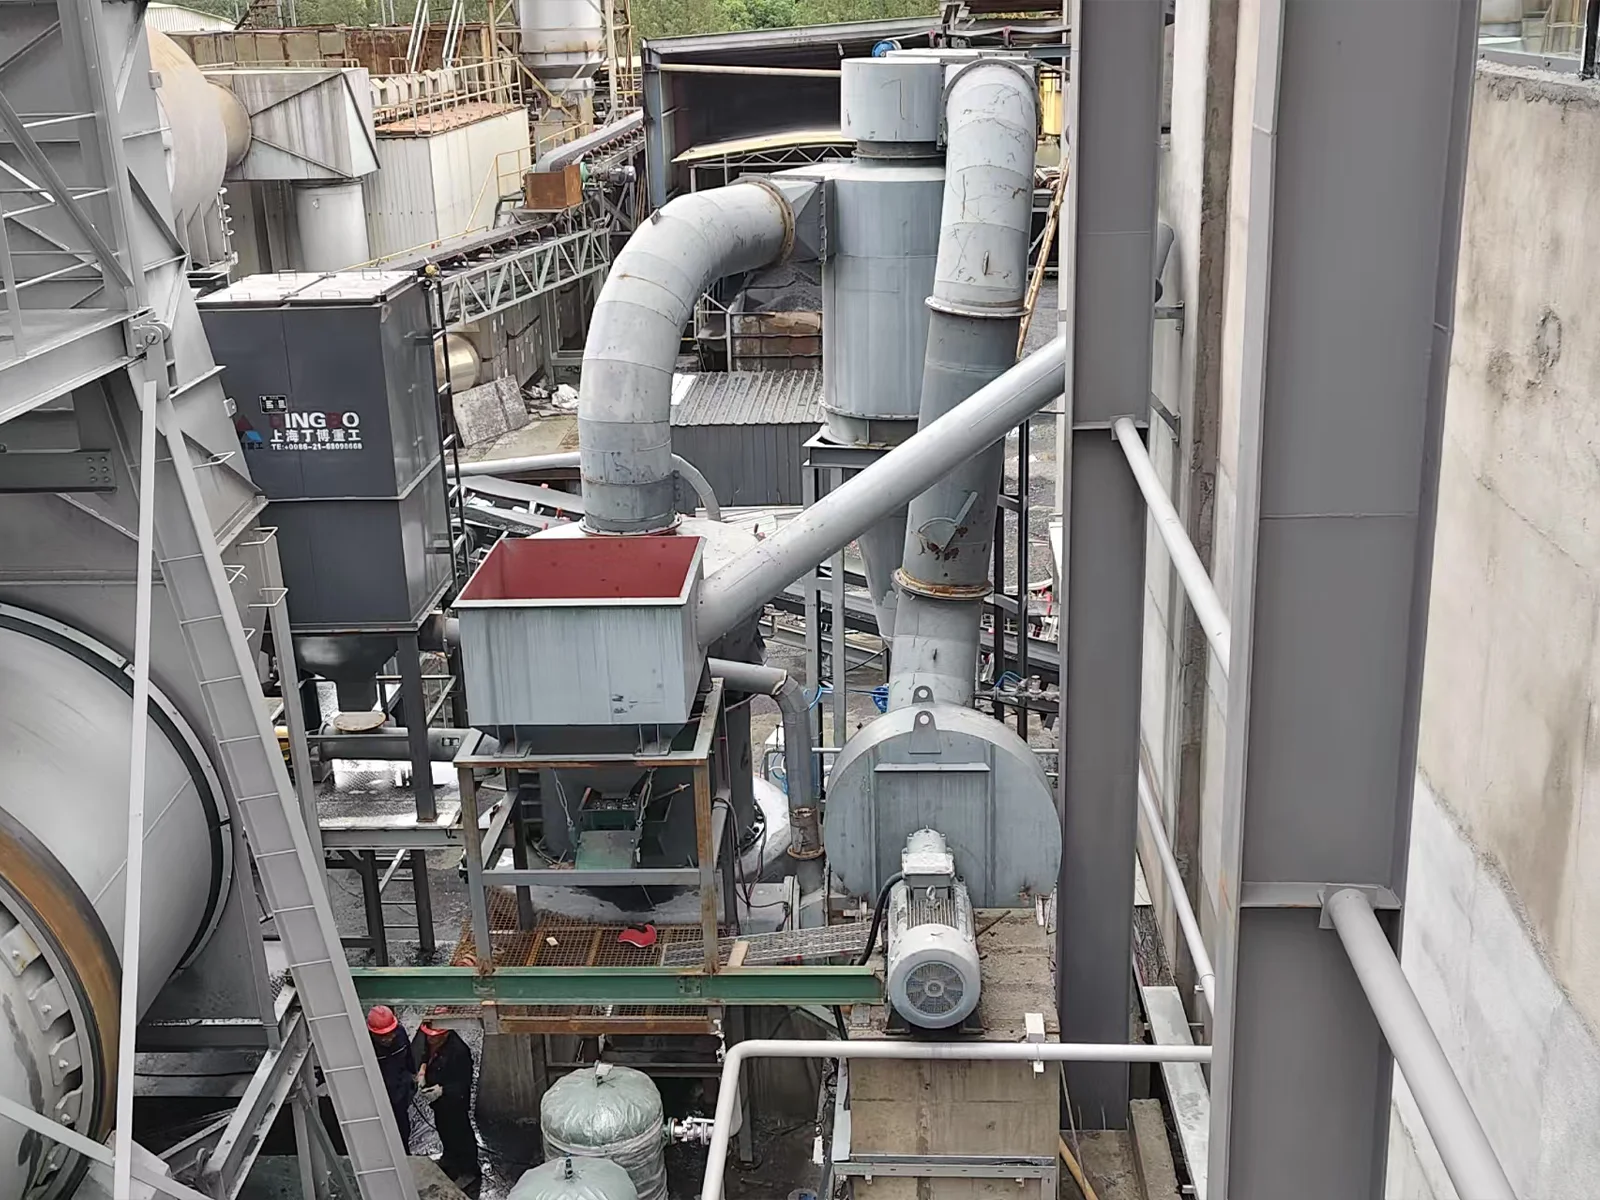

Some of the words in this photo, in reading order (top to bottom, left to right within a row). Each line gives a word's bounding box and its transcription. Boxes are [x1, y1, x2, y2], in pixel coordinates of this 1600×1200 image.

[270, 428, 362, 443] 上海丁博重工
